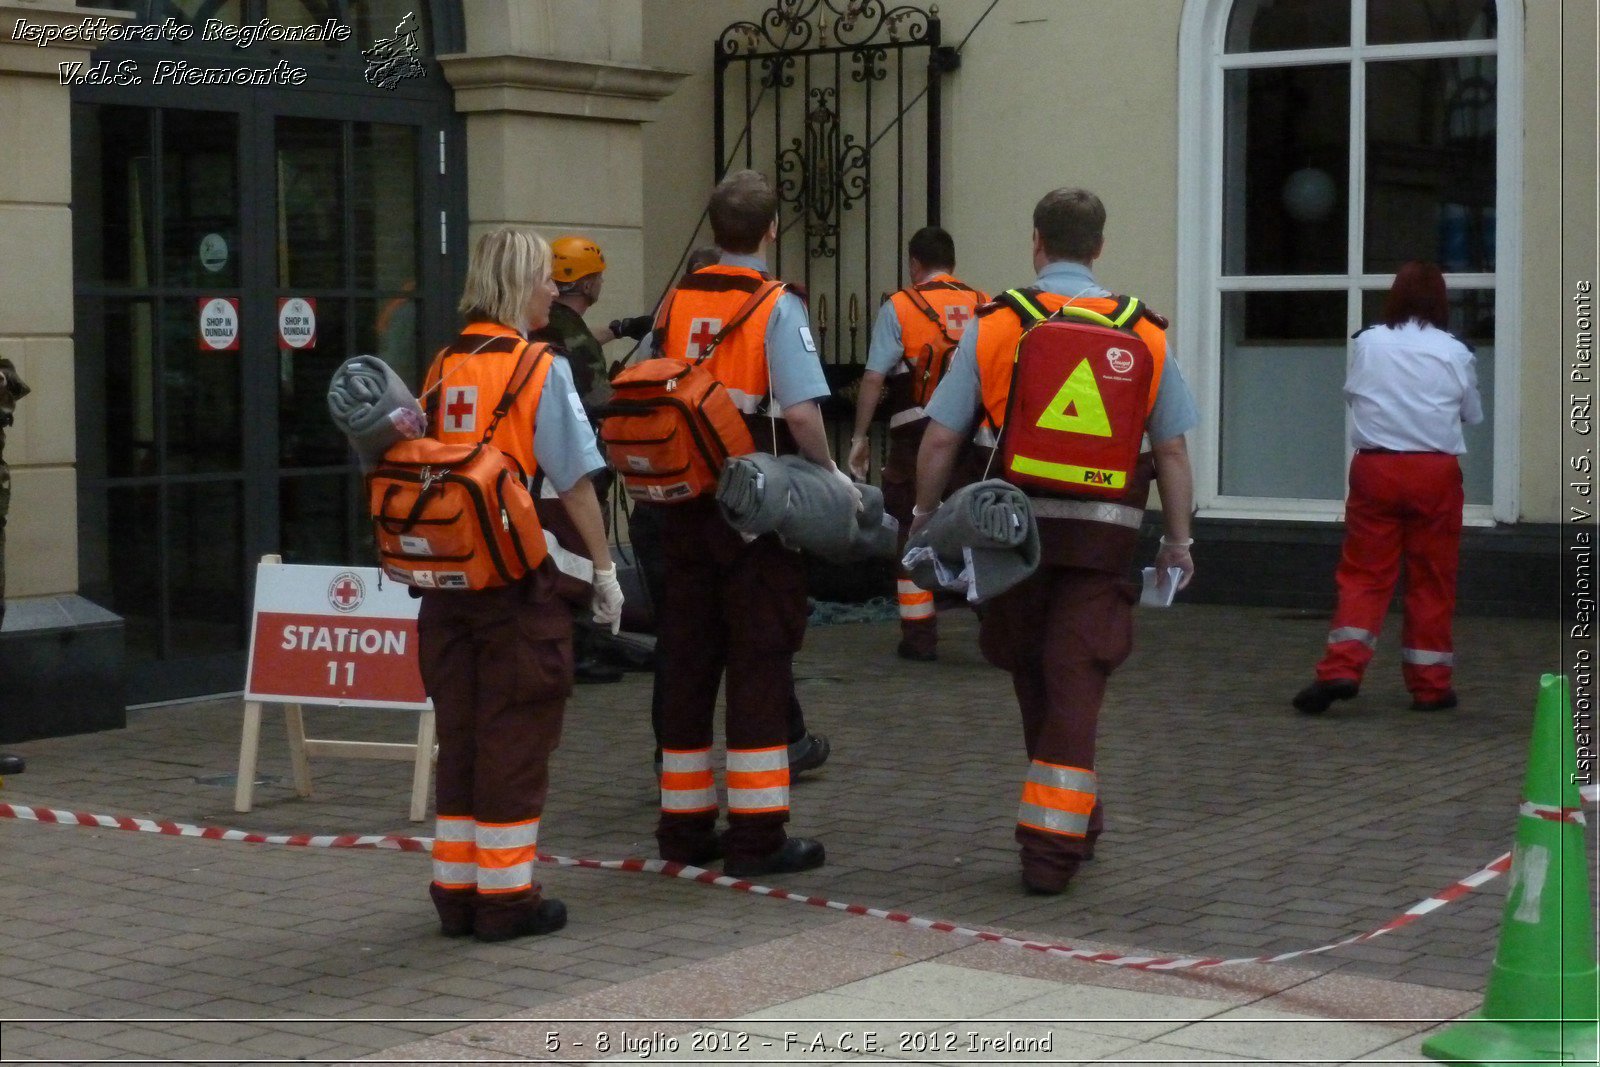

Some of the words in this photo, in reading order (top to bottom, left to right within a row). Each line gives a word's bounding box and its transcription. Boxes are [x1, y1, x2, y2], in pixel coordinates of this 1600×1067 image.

[206, 317, 224, 327] SHOP
[225, 317, 232, 327] IN
[284, 316, 301, 326] SHOP
[302, 316, 310, 326] IN
[205, 327, 234, 337] DUNDALK
[283, 326, 311, 336] DUNDALK
[326, 661, 356, 686] 11
